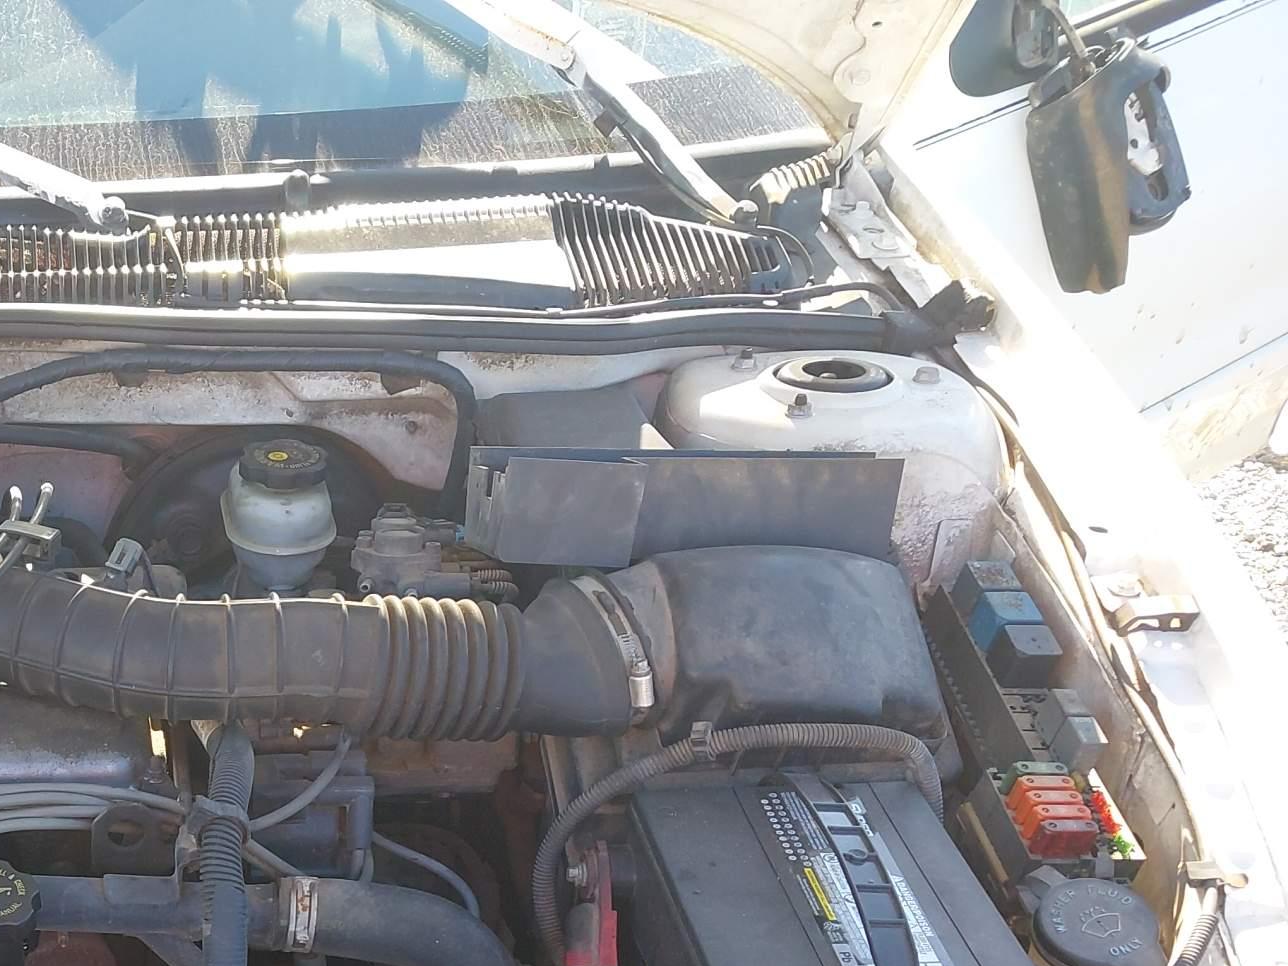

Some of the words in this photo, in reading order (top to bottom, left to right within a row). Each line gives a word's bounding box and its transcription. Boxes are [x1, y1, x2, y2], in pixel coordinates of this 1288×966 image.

[1049, 889, 1076, 933] WASHER
[1088, 884, 1132, 905] FLUID
[1110, 936, 1143, 956] ONLY
[840, 951, 852, 963] Pb
